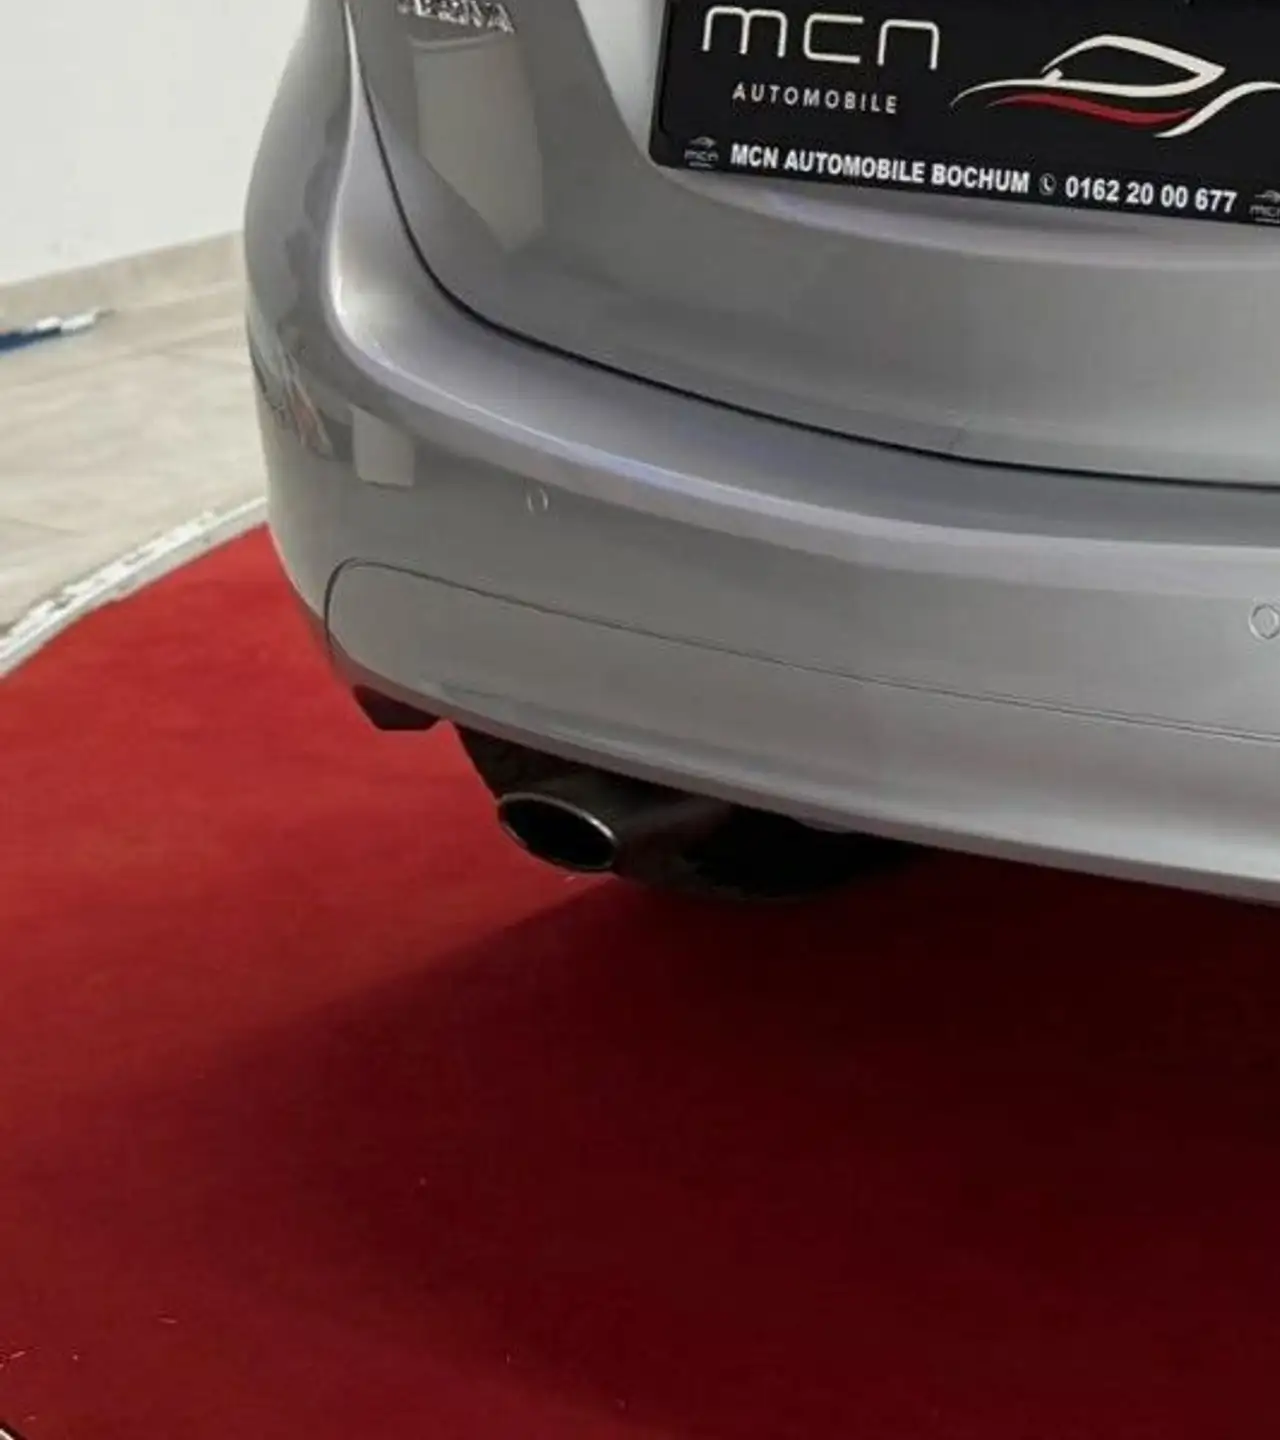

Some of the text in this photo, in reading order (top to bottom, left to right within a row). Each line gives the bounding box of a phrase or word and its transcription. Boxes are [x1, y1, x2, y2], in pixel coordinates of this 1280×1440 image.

[731, 81, 898, 115] AUTOMOBILE
[730, 142, 1238, 214] MCN AUTOMOBILE BOCHUM 0162 20 00 677
